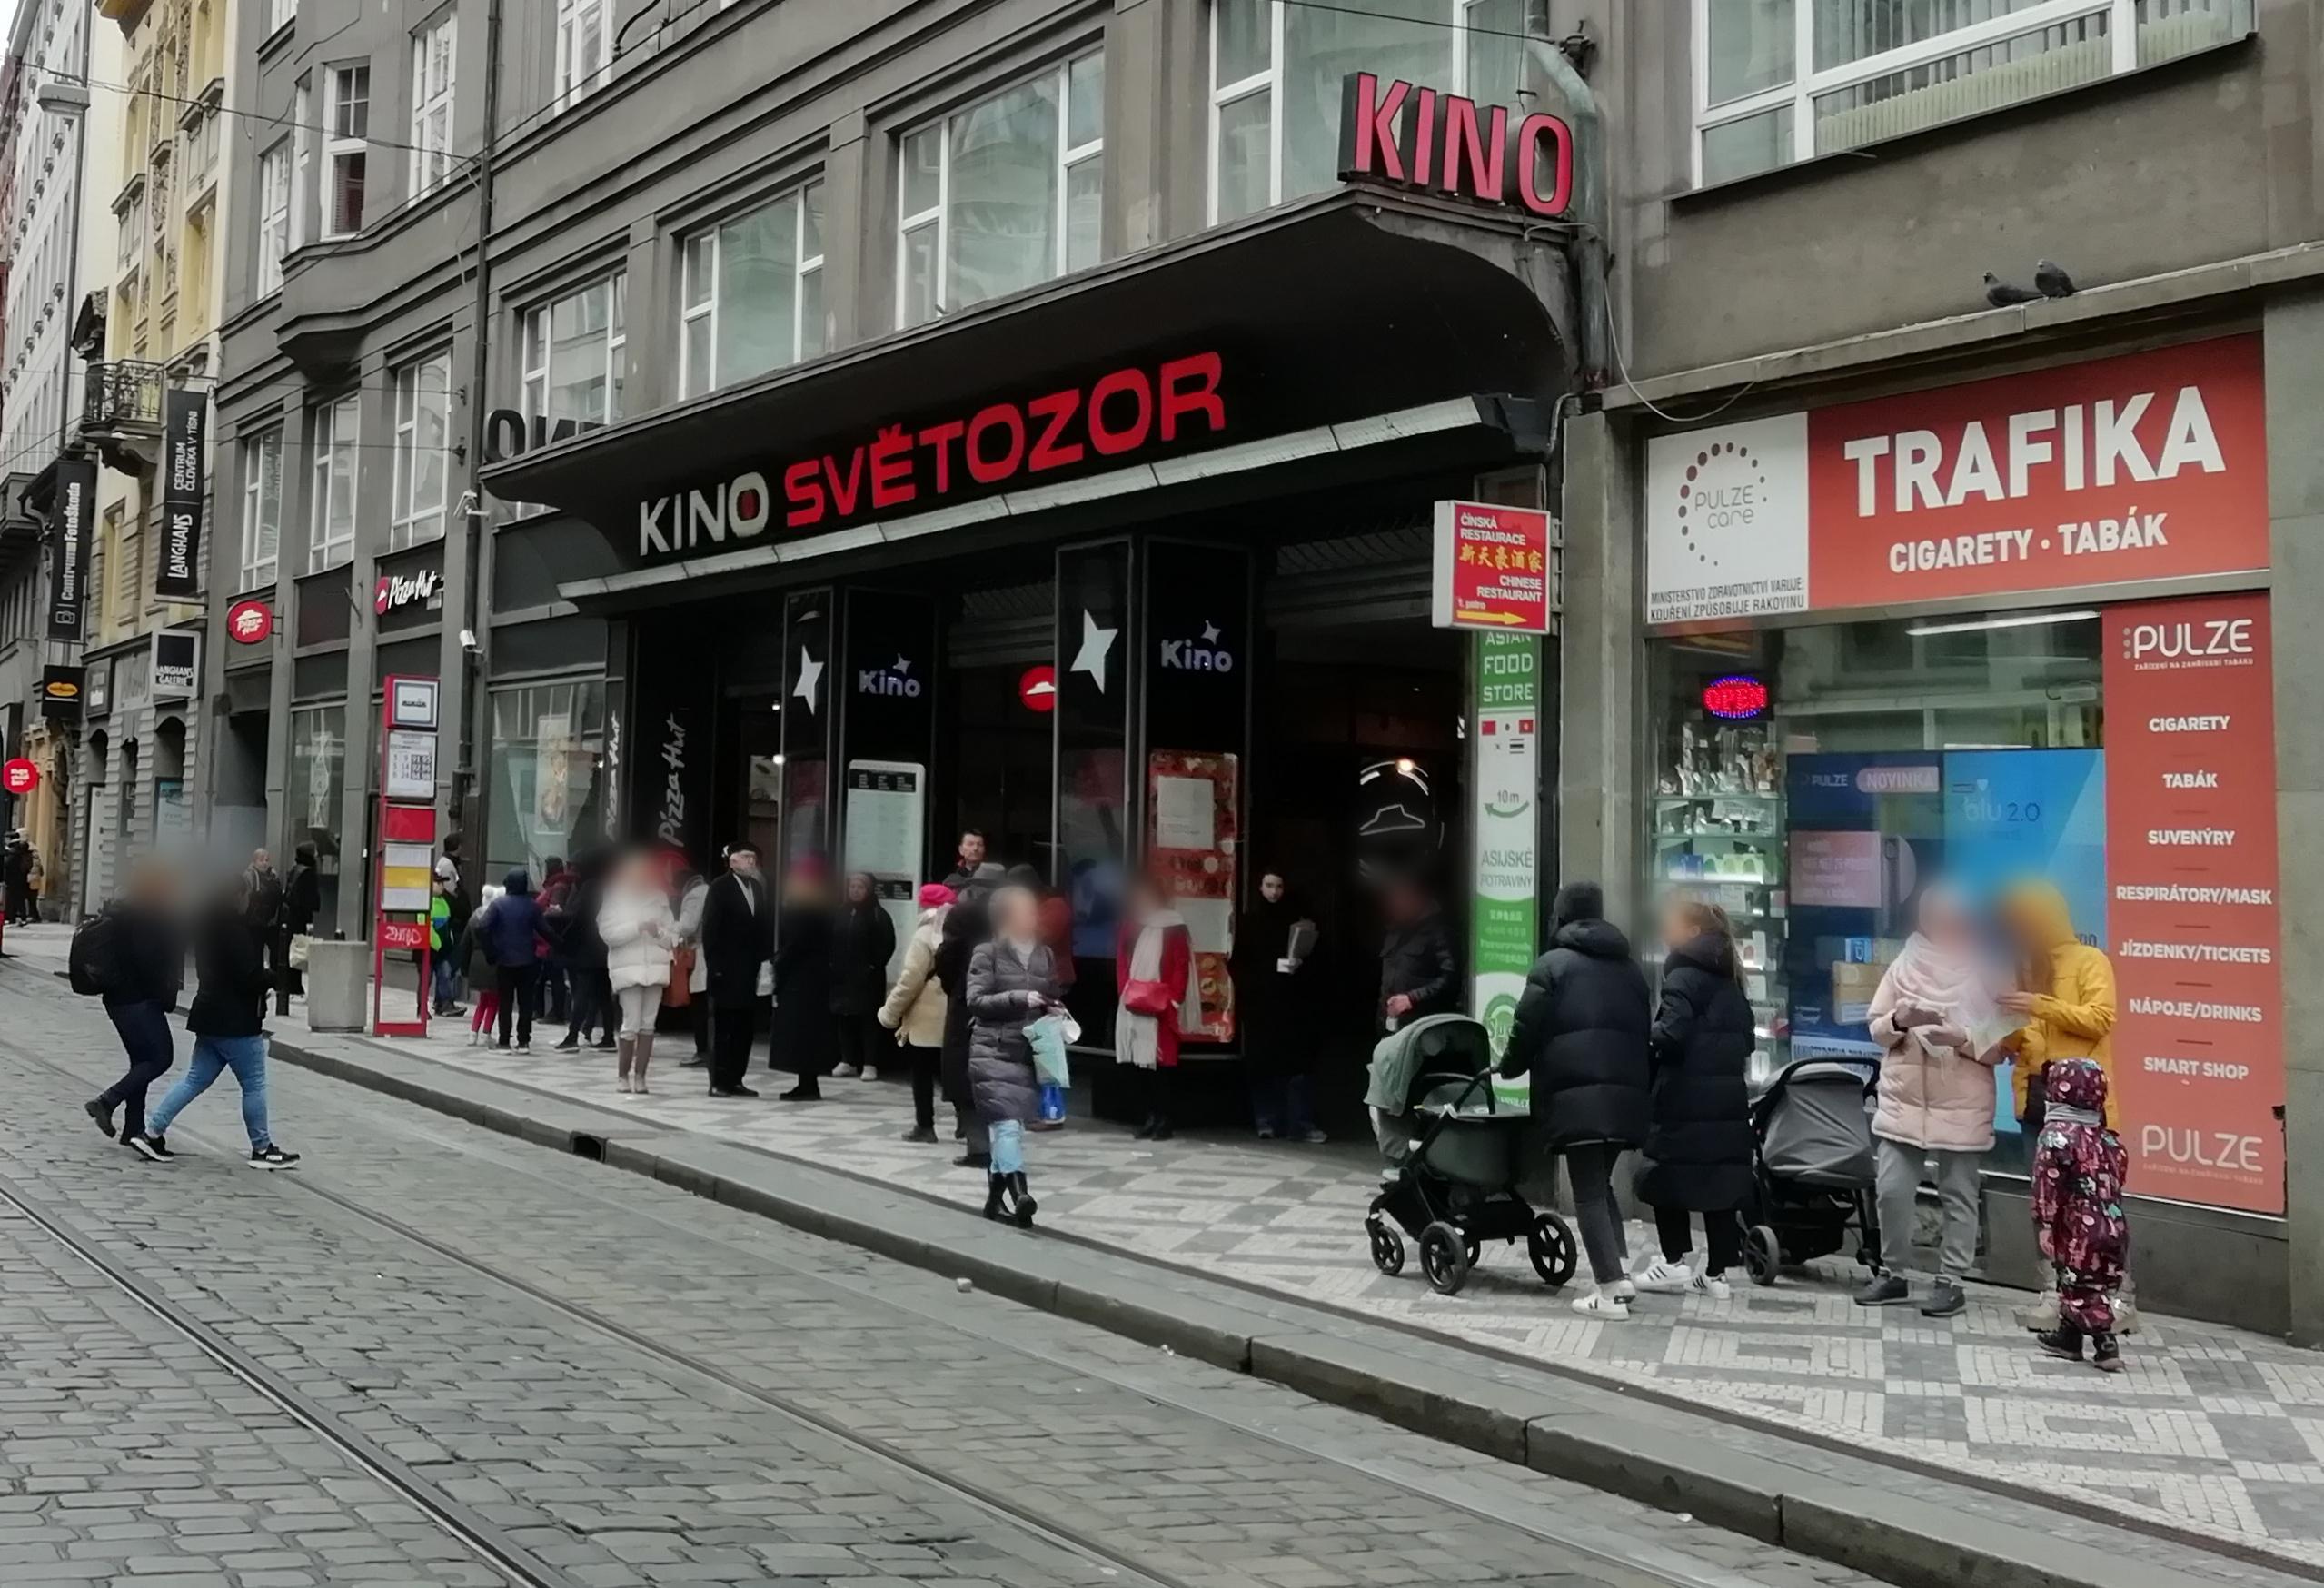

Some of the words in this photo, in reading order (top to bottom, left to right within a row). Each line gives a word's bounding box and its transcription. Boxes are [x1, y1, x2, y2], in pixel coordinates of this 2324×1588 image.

[1354, 72, 1574, 216] KINO
[640, 471, 770, 556] KINO
[785, 351, 1226, 527] SVĚTOZOR
[1844, 385, 2227, 518] TRAFIKA
[174, 442, 186, 491] CENTRUM
[1694, 484, 1754, 511] PULZE
[1707, 508, 1754, 529] care
[167, 514, 193, 579] LANGHANS
[1460, 528, 1526, 545] RESTAURACE
[1889, 529, 2033, 573] CIGARETY
[2058, 506, 2169, 556] TABÁK
[414, 570, 438, 600] Hut
[1476, 586, 1543, 602] RESTAURANT
[1499, 575, 1543, 590] CHINESE
[1753, 595, 1805, 611] RAKOVINU
[2133, 619, 2253, 659] PULZE
[1160, 638, 1233, 674] Kino
[1484, 653, 1534, 675] FOOD
[859, 670, 921, 698] Kino
[1483, 683, 1534, 702] STORE
[2149, 716, 2230, 732] CIGARETY
[661, 713, 686, 769] Hut
[2162, 769, 2218, 788] TABÁK
[658, 772, 685, 848] Pizza
[2006, 802, 2041, 822] 2.0
[2147, 828, 2235, 846] SUVENÝRY
[1482, 849, 1533, 868] ASIJSKÉ
[1480, 874, 1533, 888] POTRAVINY
[2116, 884, 2272, 906] RESPIRÁTORY/MASK
[2119, 939, 2271, 964] JÍZDENKY/TICKETS
[2130, 997, 2263, 1022] NÁPOJE/DRINKS
[2144, 1057, 2200, 1076] SMART
[2202, 1061, 2249, 1080] SHOP
[2141, 1125, 2264, 1172] PULZE
